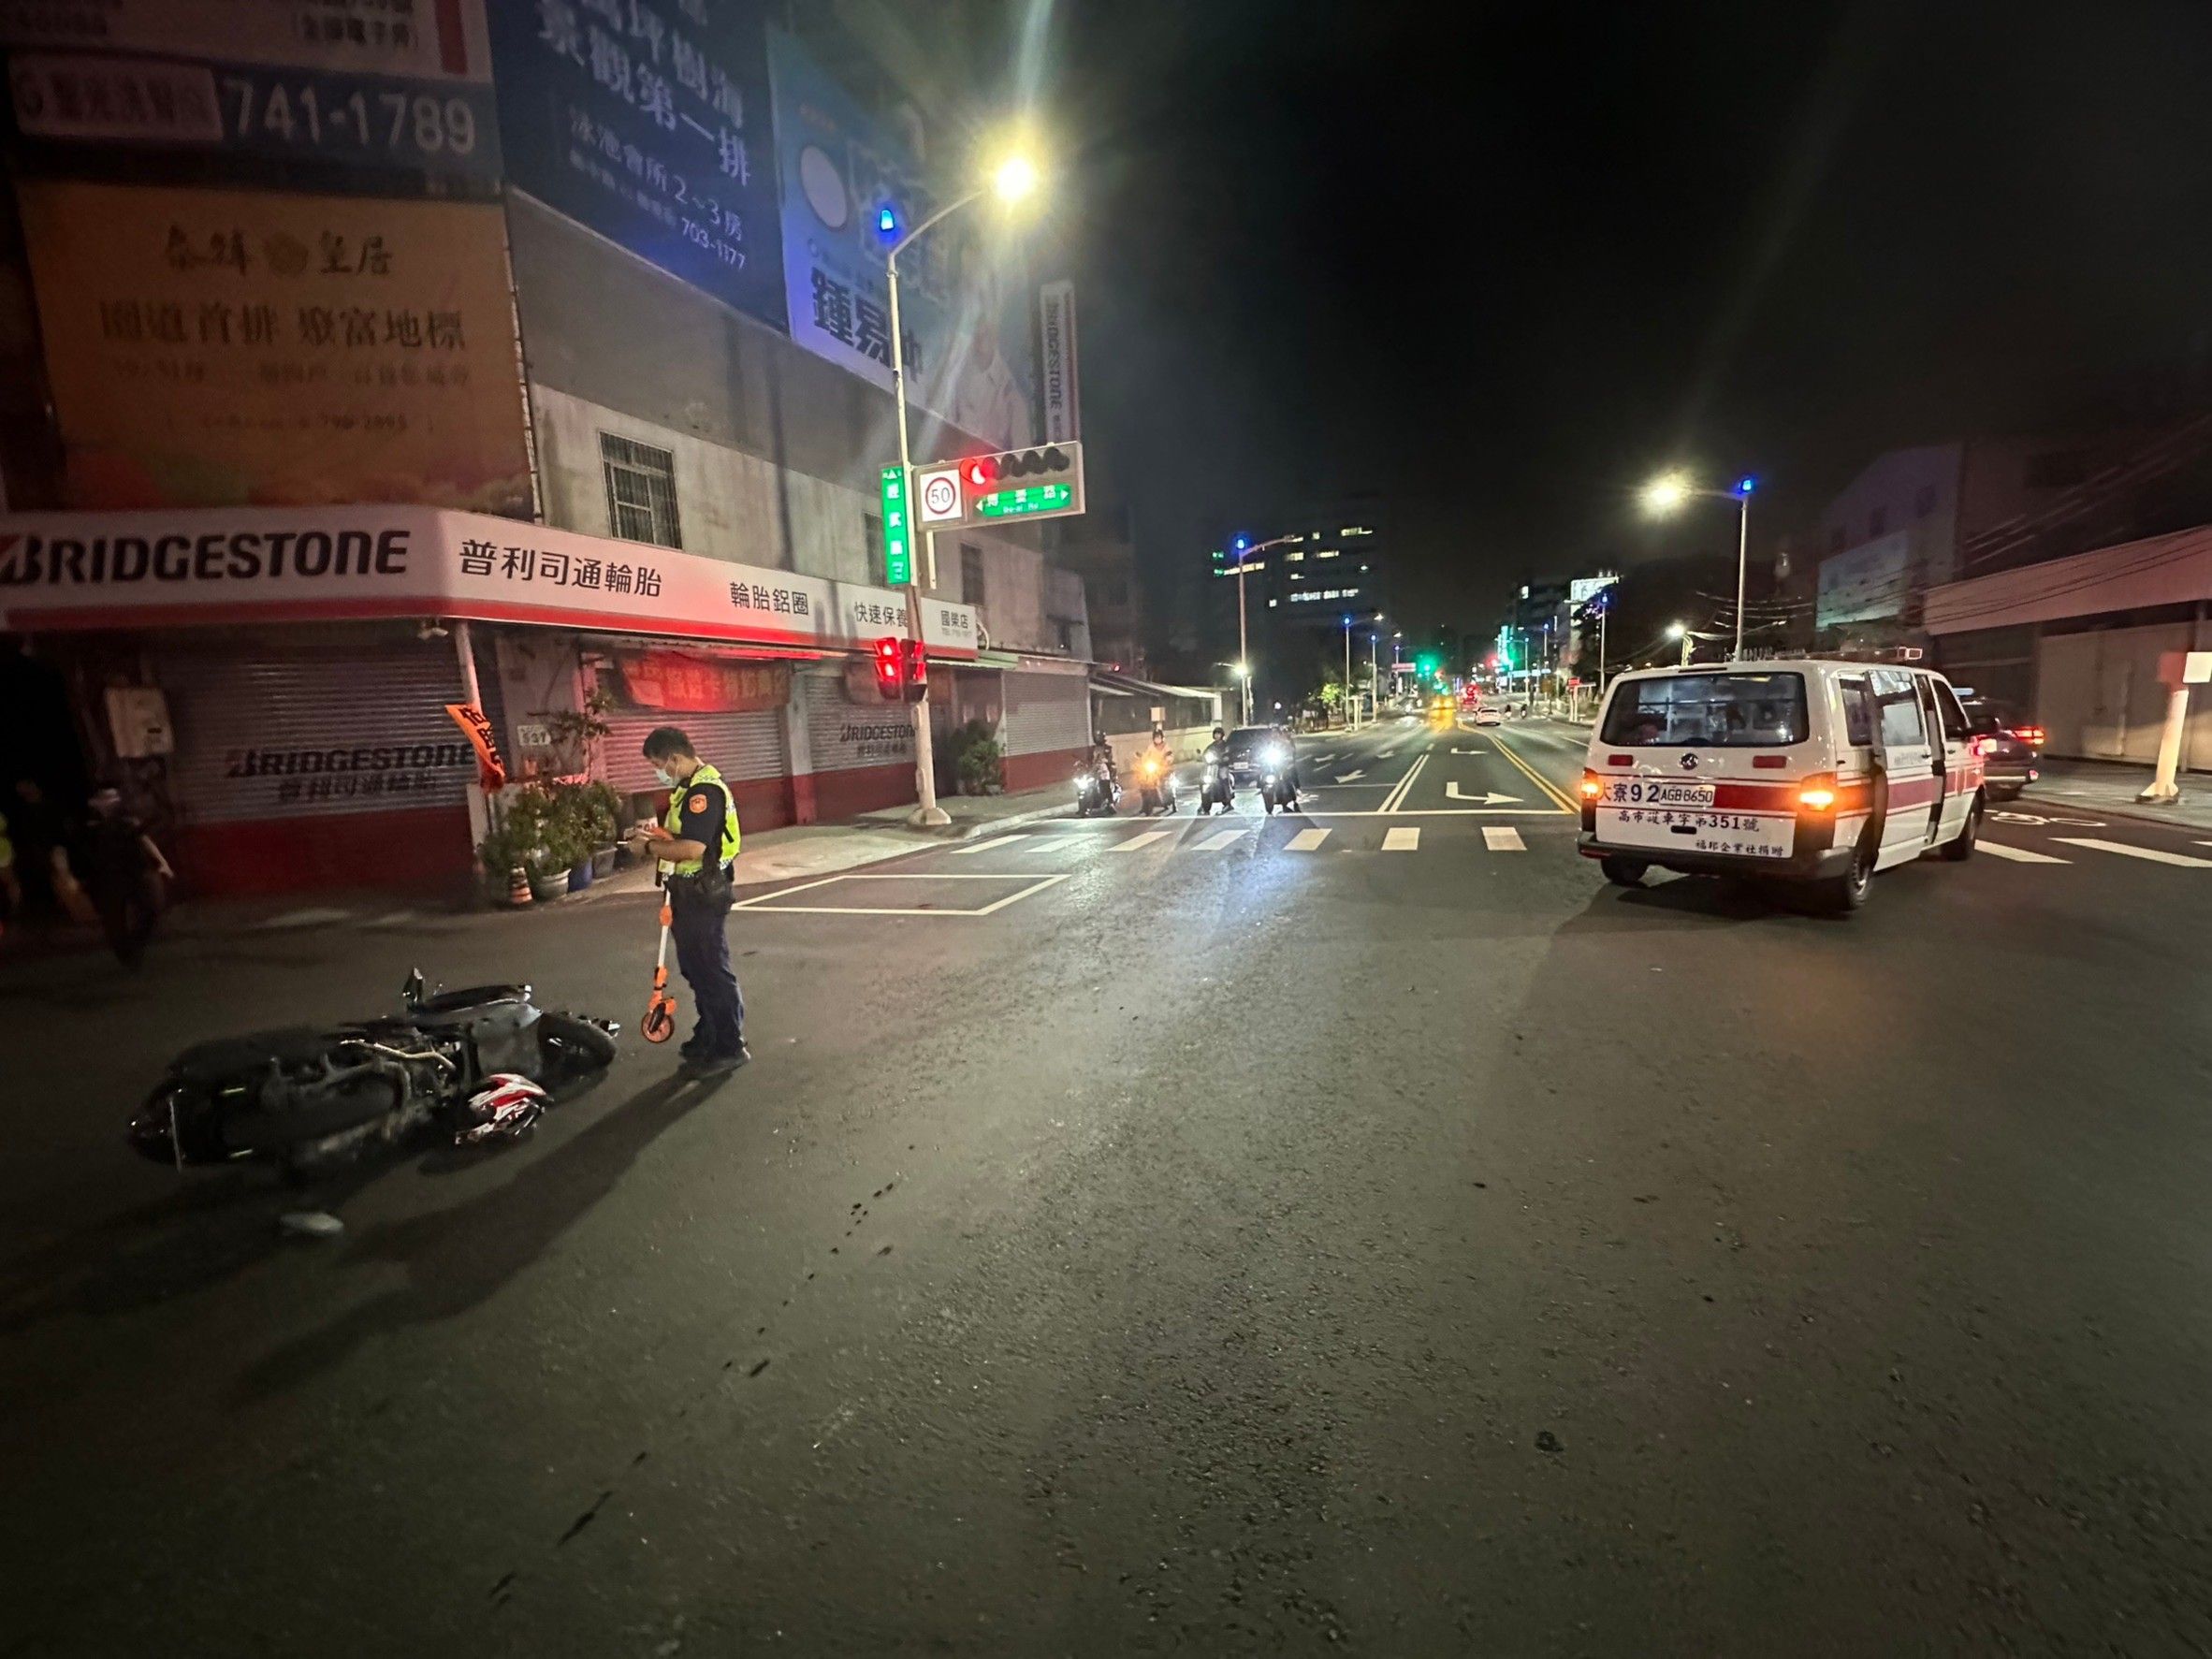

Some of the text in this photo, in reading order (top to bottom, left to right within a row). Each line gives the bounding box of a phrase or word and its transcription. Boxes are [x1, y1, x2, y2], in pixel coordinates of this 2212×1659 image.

[223, 79, 475, 156] 741-1789
[681, 216, 746, 270] 703-1177
[930, 487, 952, 504] 50
[0, 531, 411, 586] BRIDGESTONE
[459, 539, 662, 597] 普利司通輪胎
[729, 581, 809, 617] 輪胎鋁圈
[853, 602, 909, 629] 快速保養
[840, 724, 916, 743] BRIDGESTON
[226, 744, 477, 779] BRIDGESTONE
